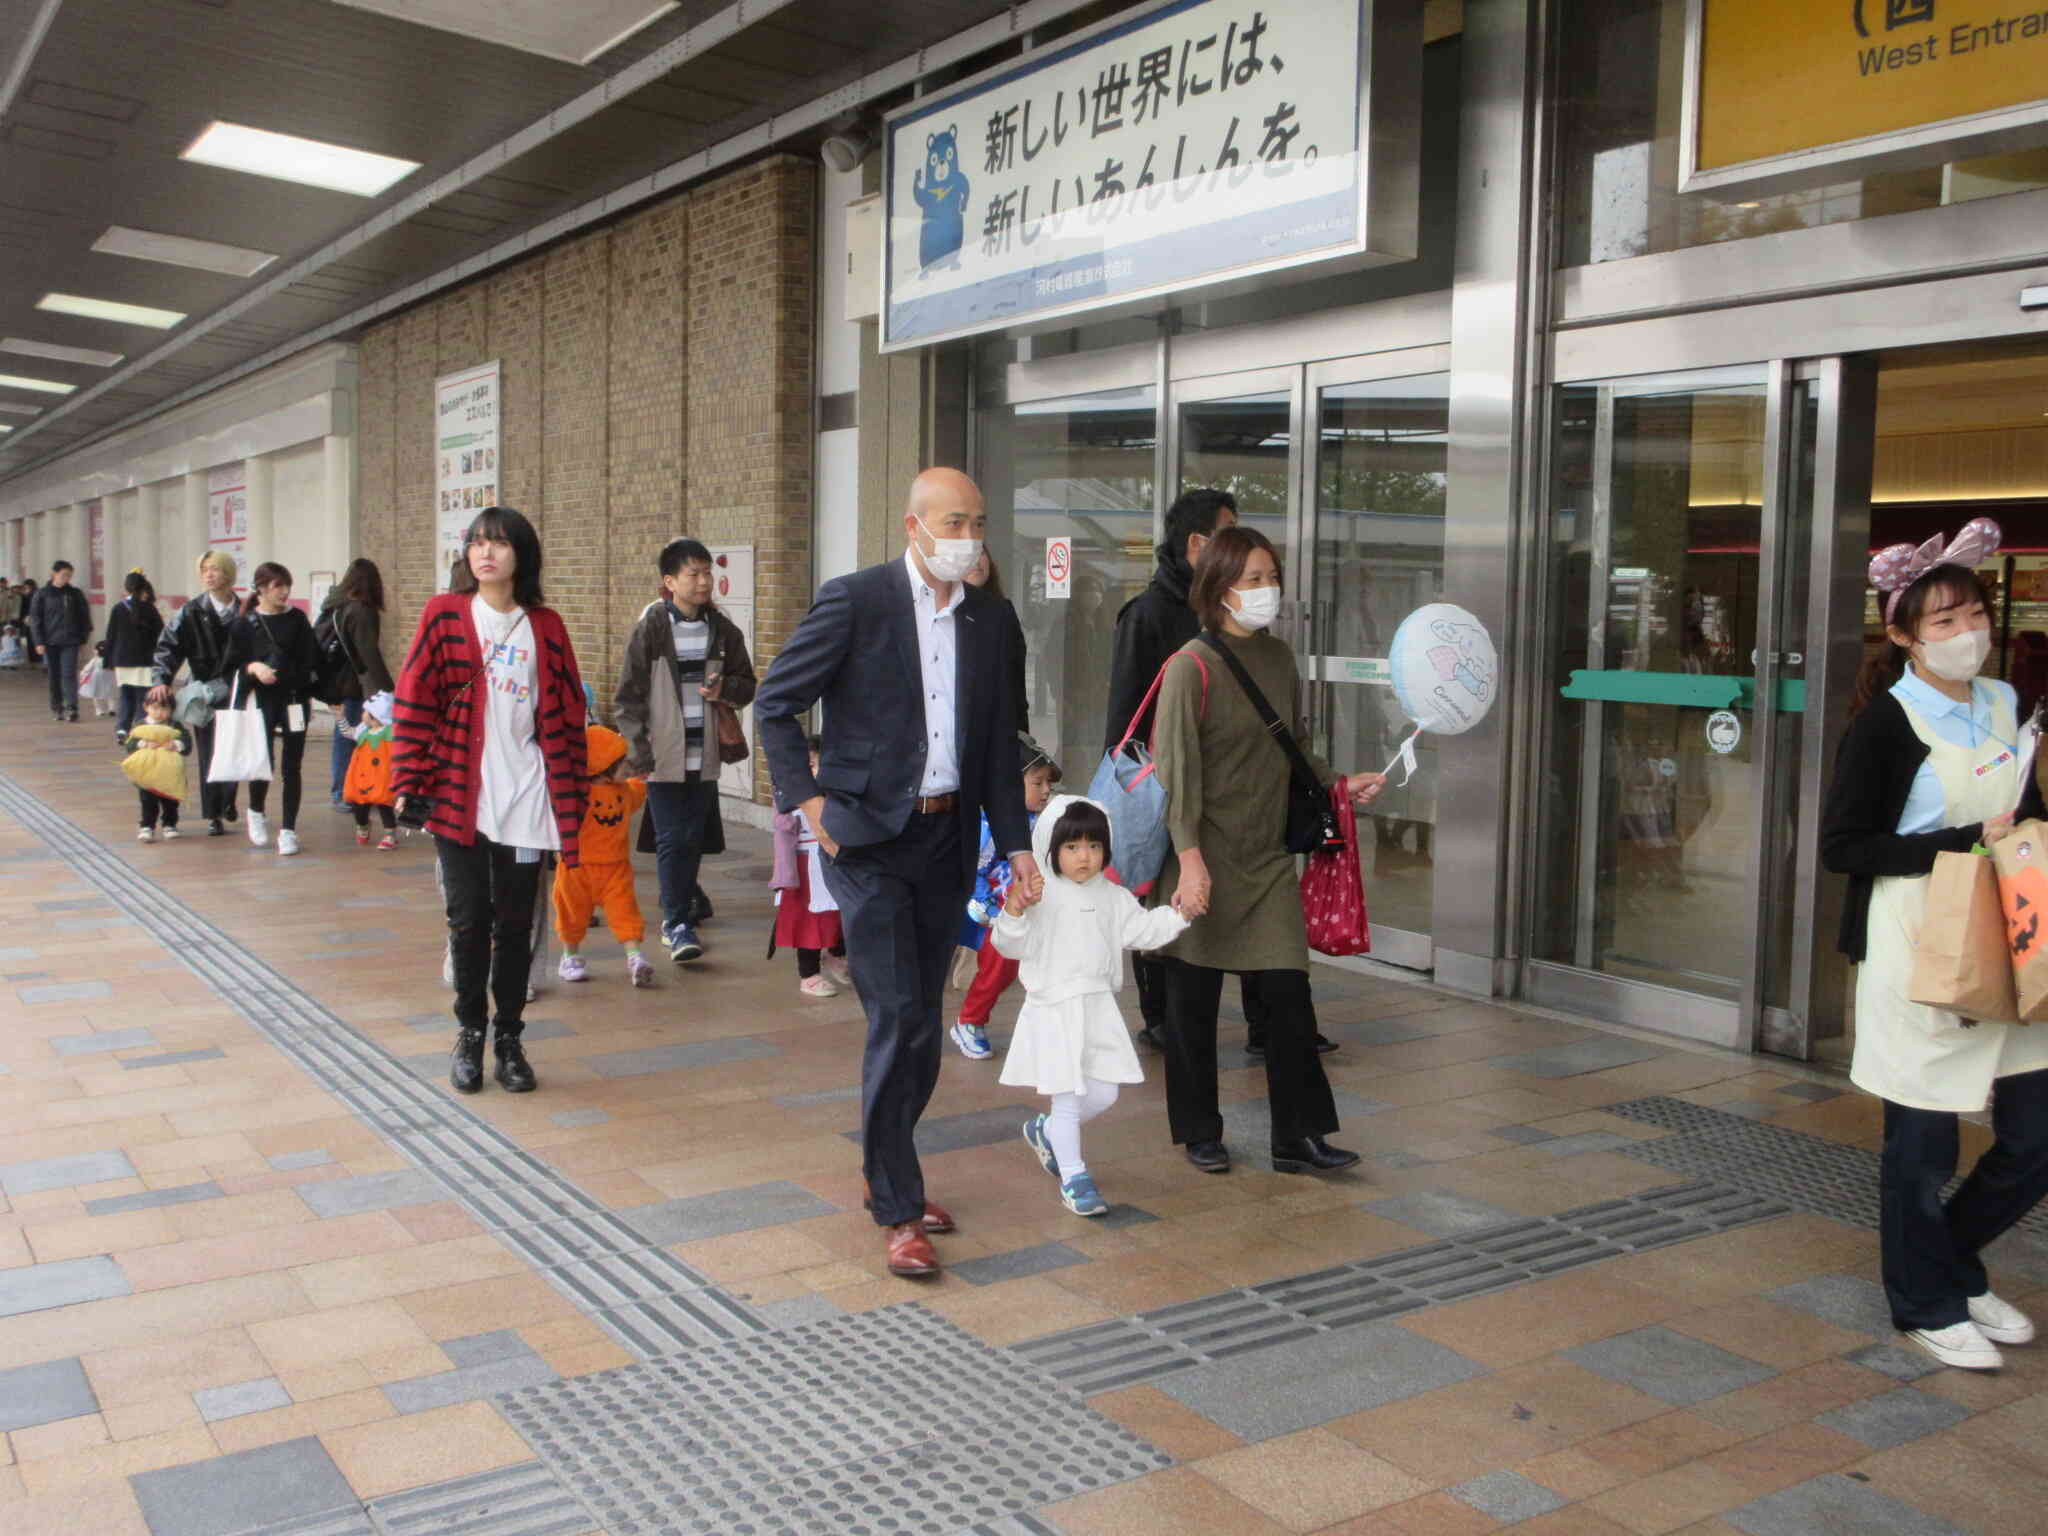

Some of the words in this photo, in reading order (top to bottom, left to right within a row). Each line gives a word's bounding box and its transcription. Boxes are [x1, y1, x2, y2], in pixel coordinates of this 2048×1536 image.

[984, 11, 1286, 175] 新しい世界には、
[1858, 34, 1938, 76] West
[981, 101, 1319, 258] 新しいあんしんを。
